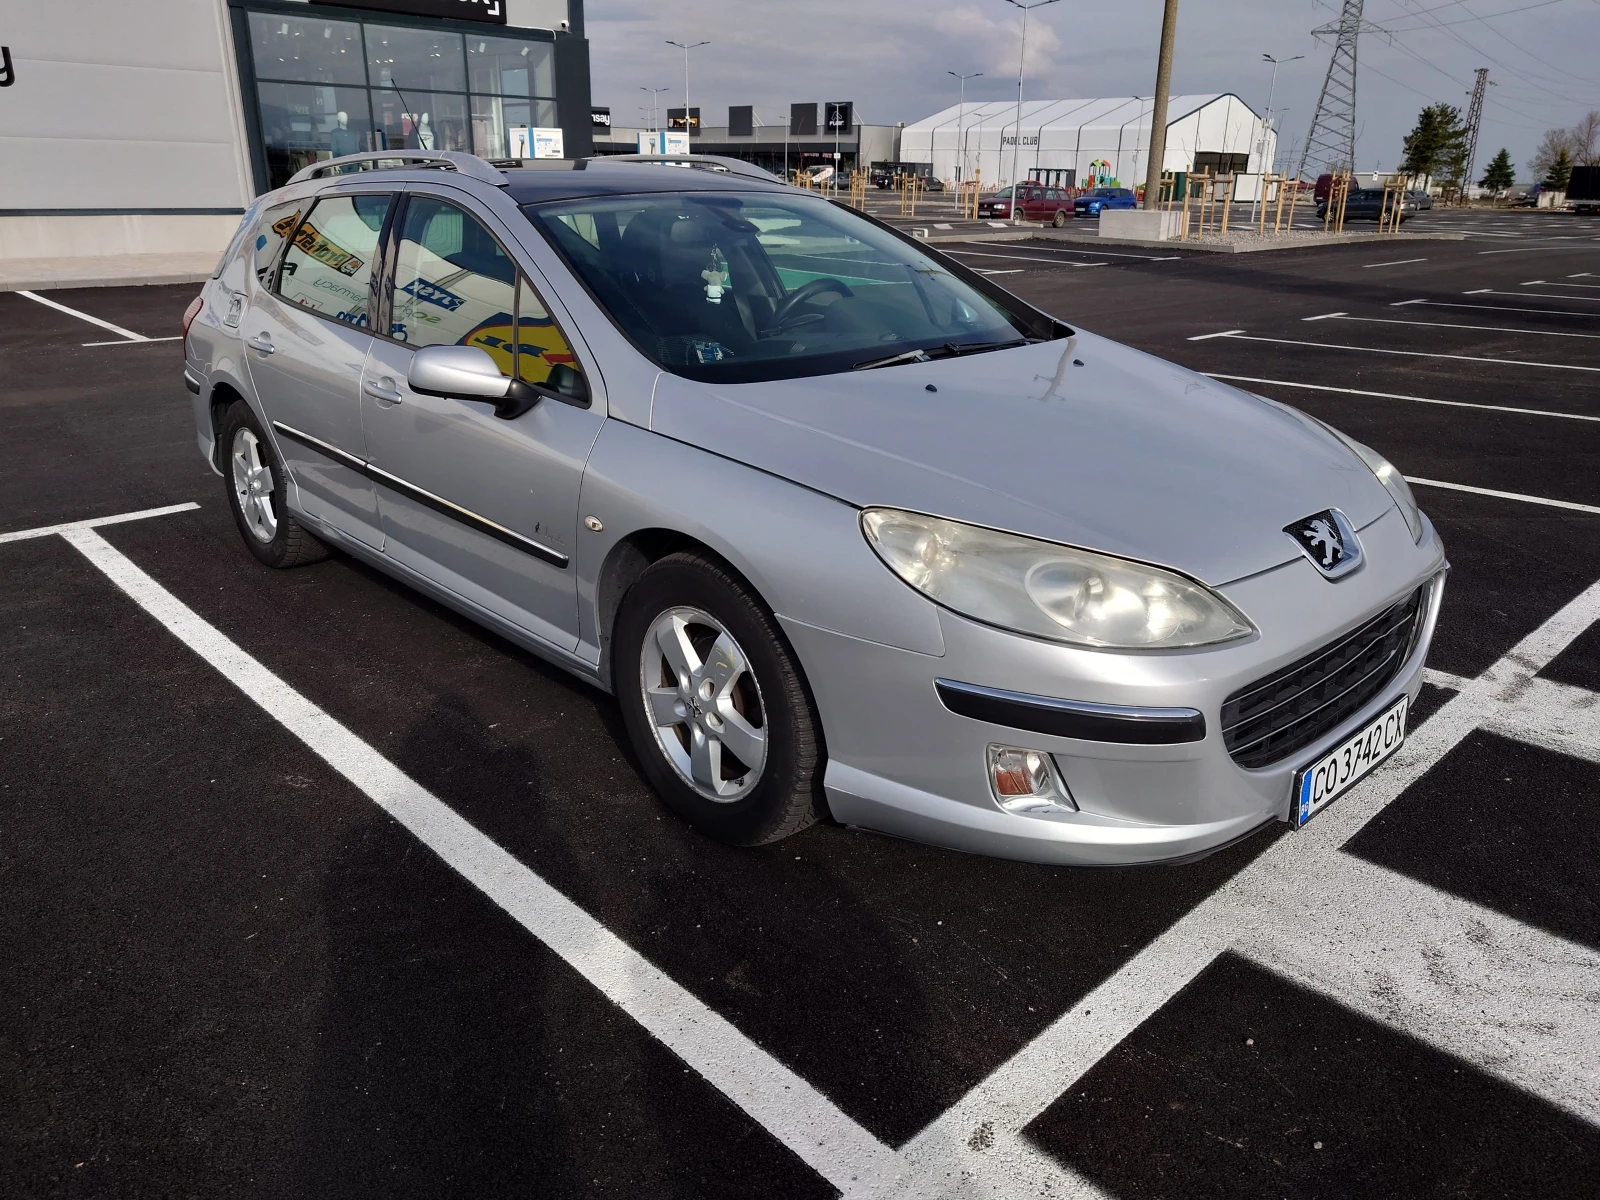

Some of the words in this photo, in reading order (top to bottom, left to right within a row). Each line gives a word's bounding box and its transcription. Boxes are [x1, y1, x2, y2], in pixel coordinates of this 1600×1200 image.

[1022, 136, 1038, 146] CLUB
[1313, 758, 1338, 804] CO
[1340, 724, 1382, 784] 3742
[1384, 704, 1405, 750] CX
